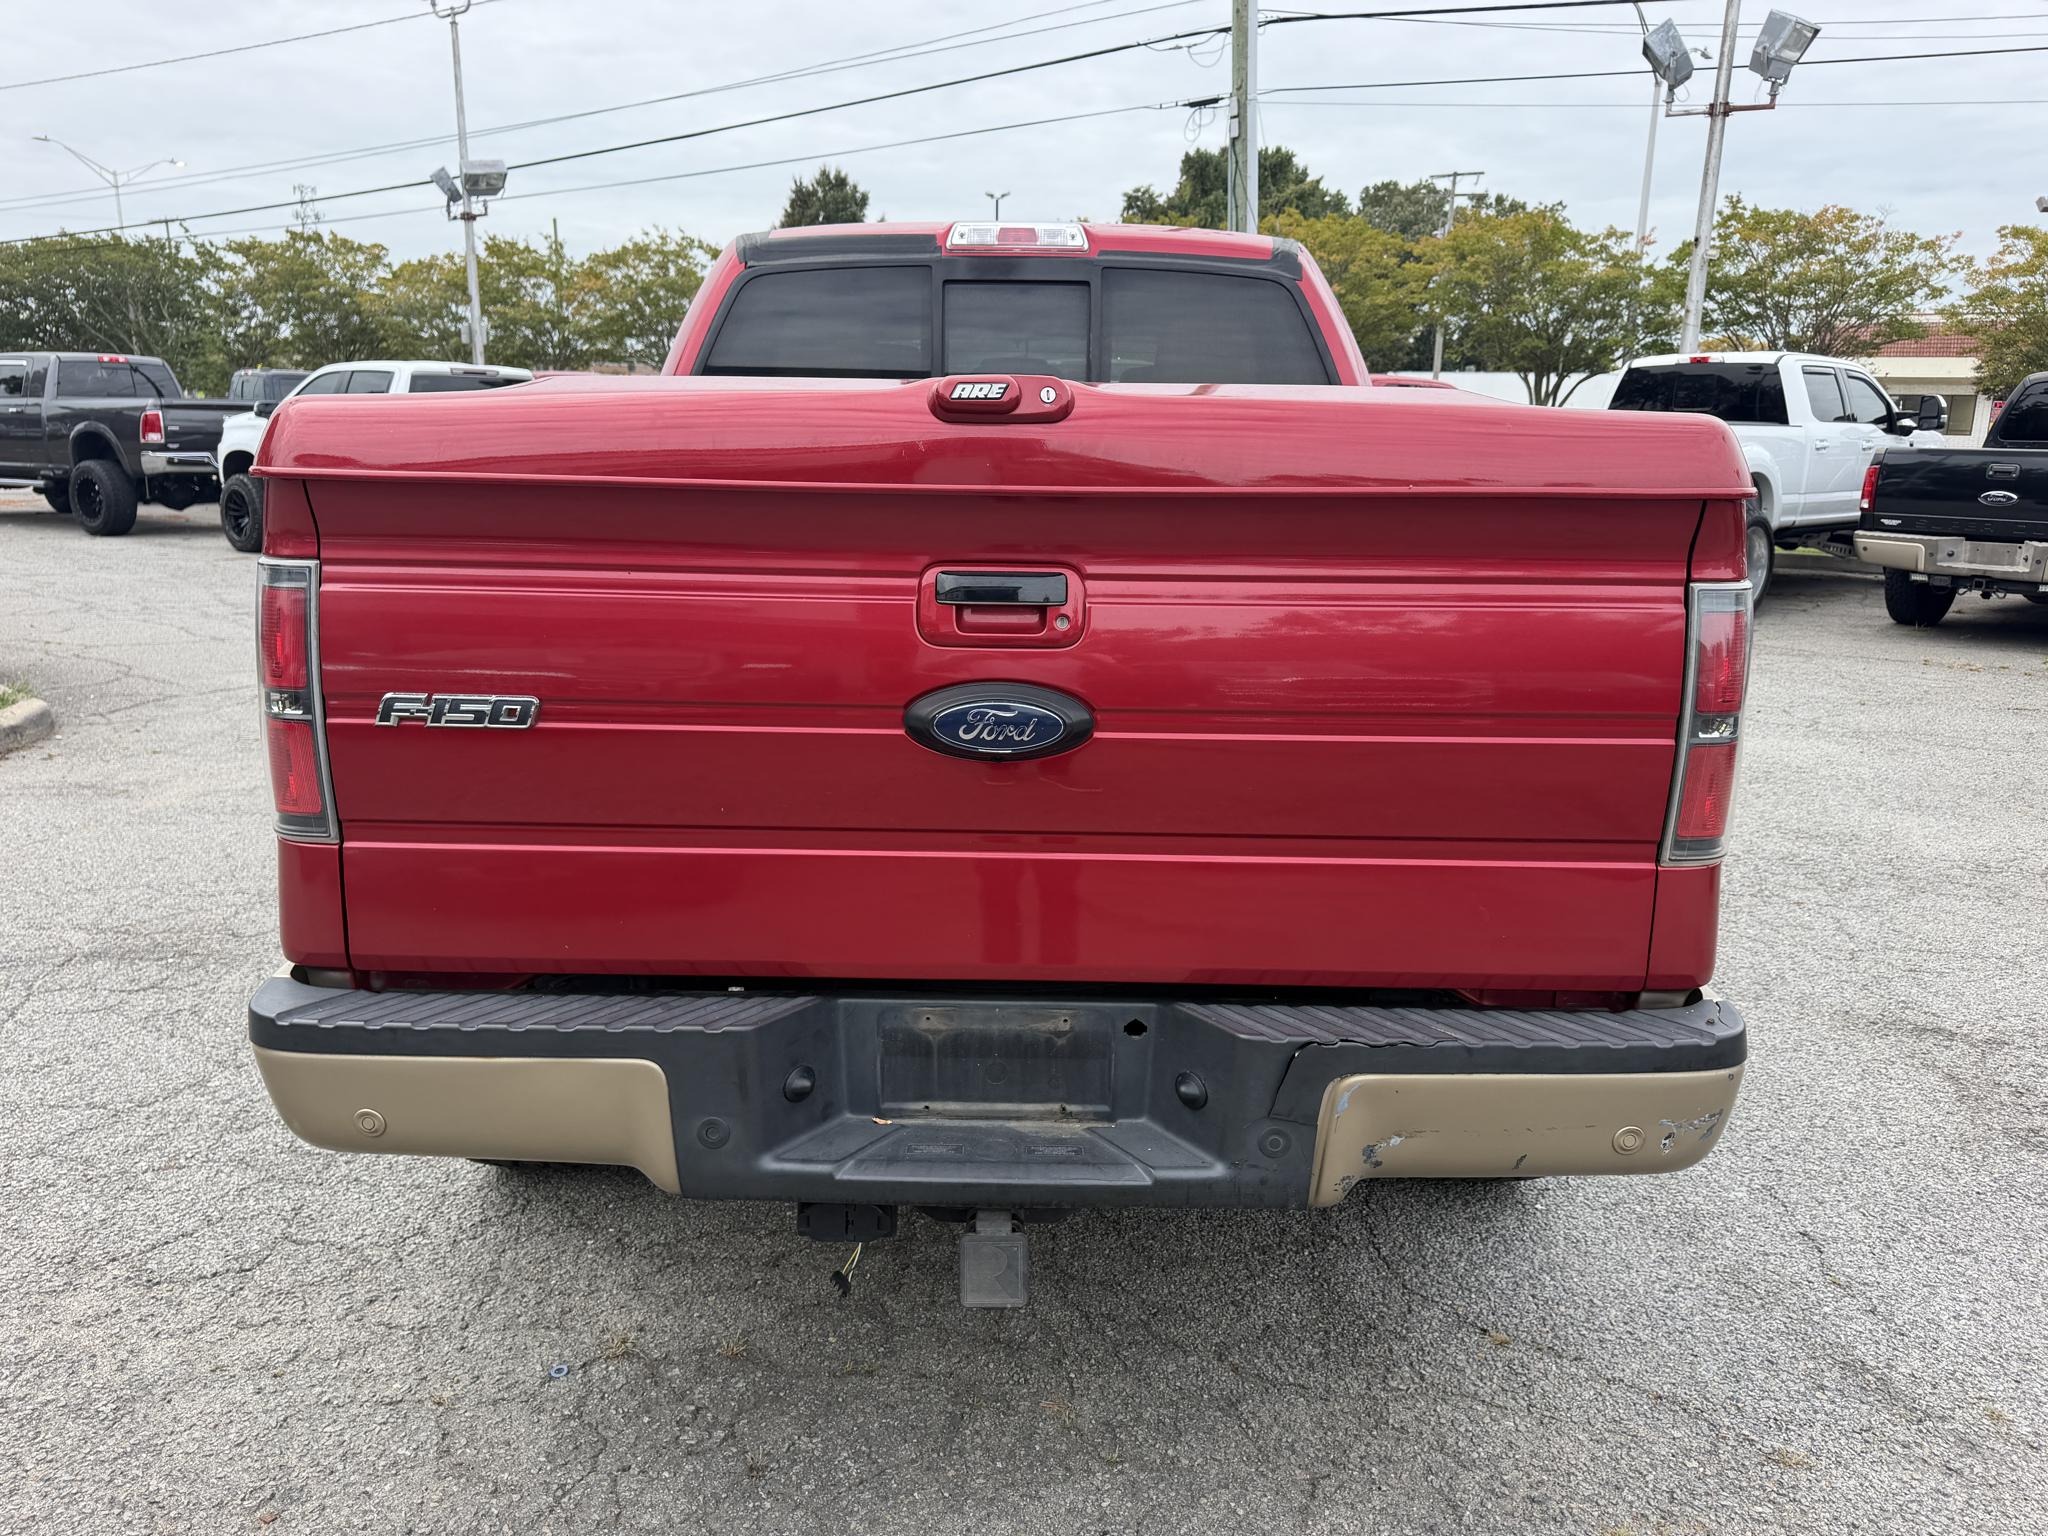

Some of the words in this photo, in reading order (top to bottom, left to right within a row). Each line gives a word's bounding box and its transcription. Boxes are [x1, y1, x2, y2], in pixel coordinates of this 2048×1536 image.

[949, 382, 1009, 399] ARE
[375, 692, 539, 729] F-150
[958, 708, 1038, 742] Ford
